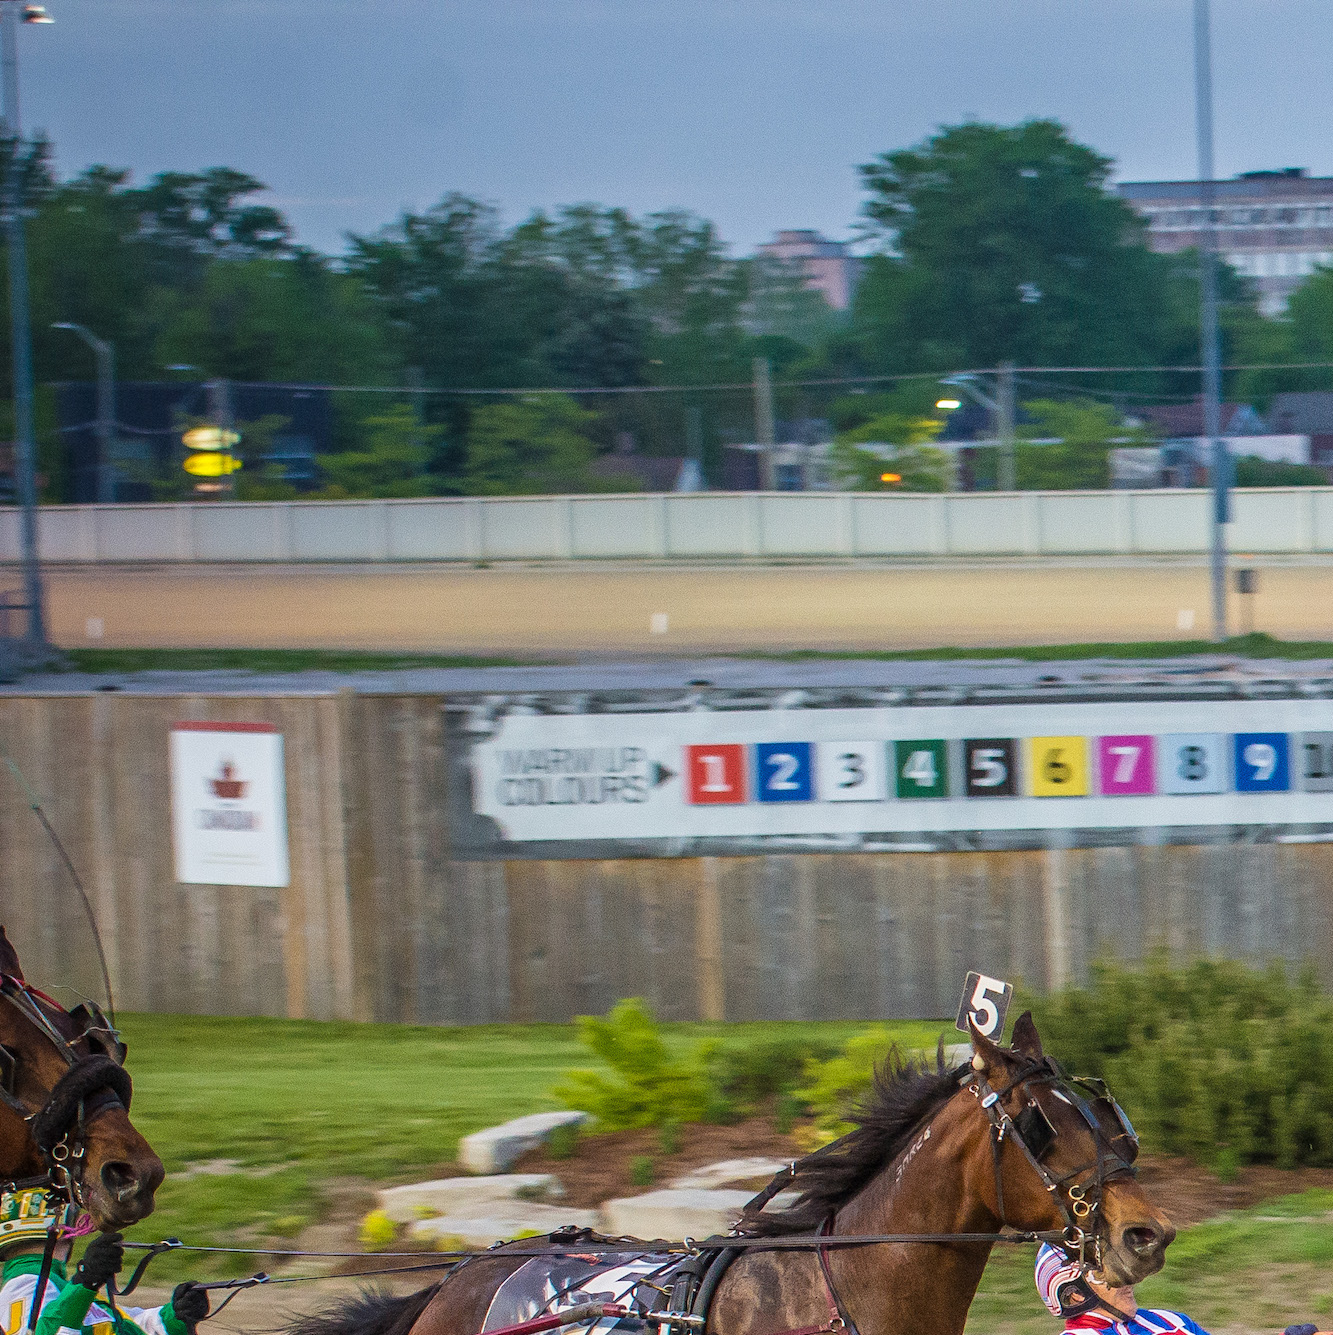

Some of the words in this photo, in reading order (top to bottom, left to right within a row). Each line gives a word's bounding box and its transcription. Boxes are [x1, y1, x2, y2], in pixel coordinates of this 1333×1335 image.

[698, 757, 732, 792] 1
[768, 754, 799, 790] 2
[837, 753, 865, 788] 3
[902, 751, 938, 787] 4
[971, 750, 1008, 786] 5
[1043, 748, 1074, 785] 6
[1107, 747, 1142, 783] 7
[1177, 746, 1208, 781] 8
[1243, 744, 1278, 782] 9
[969, 974, 1006, 1037] 5
